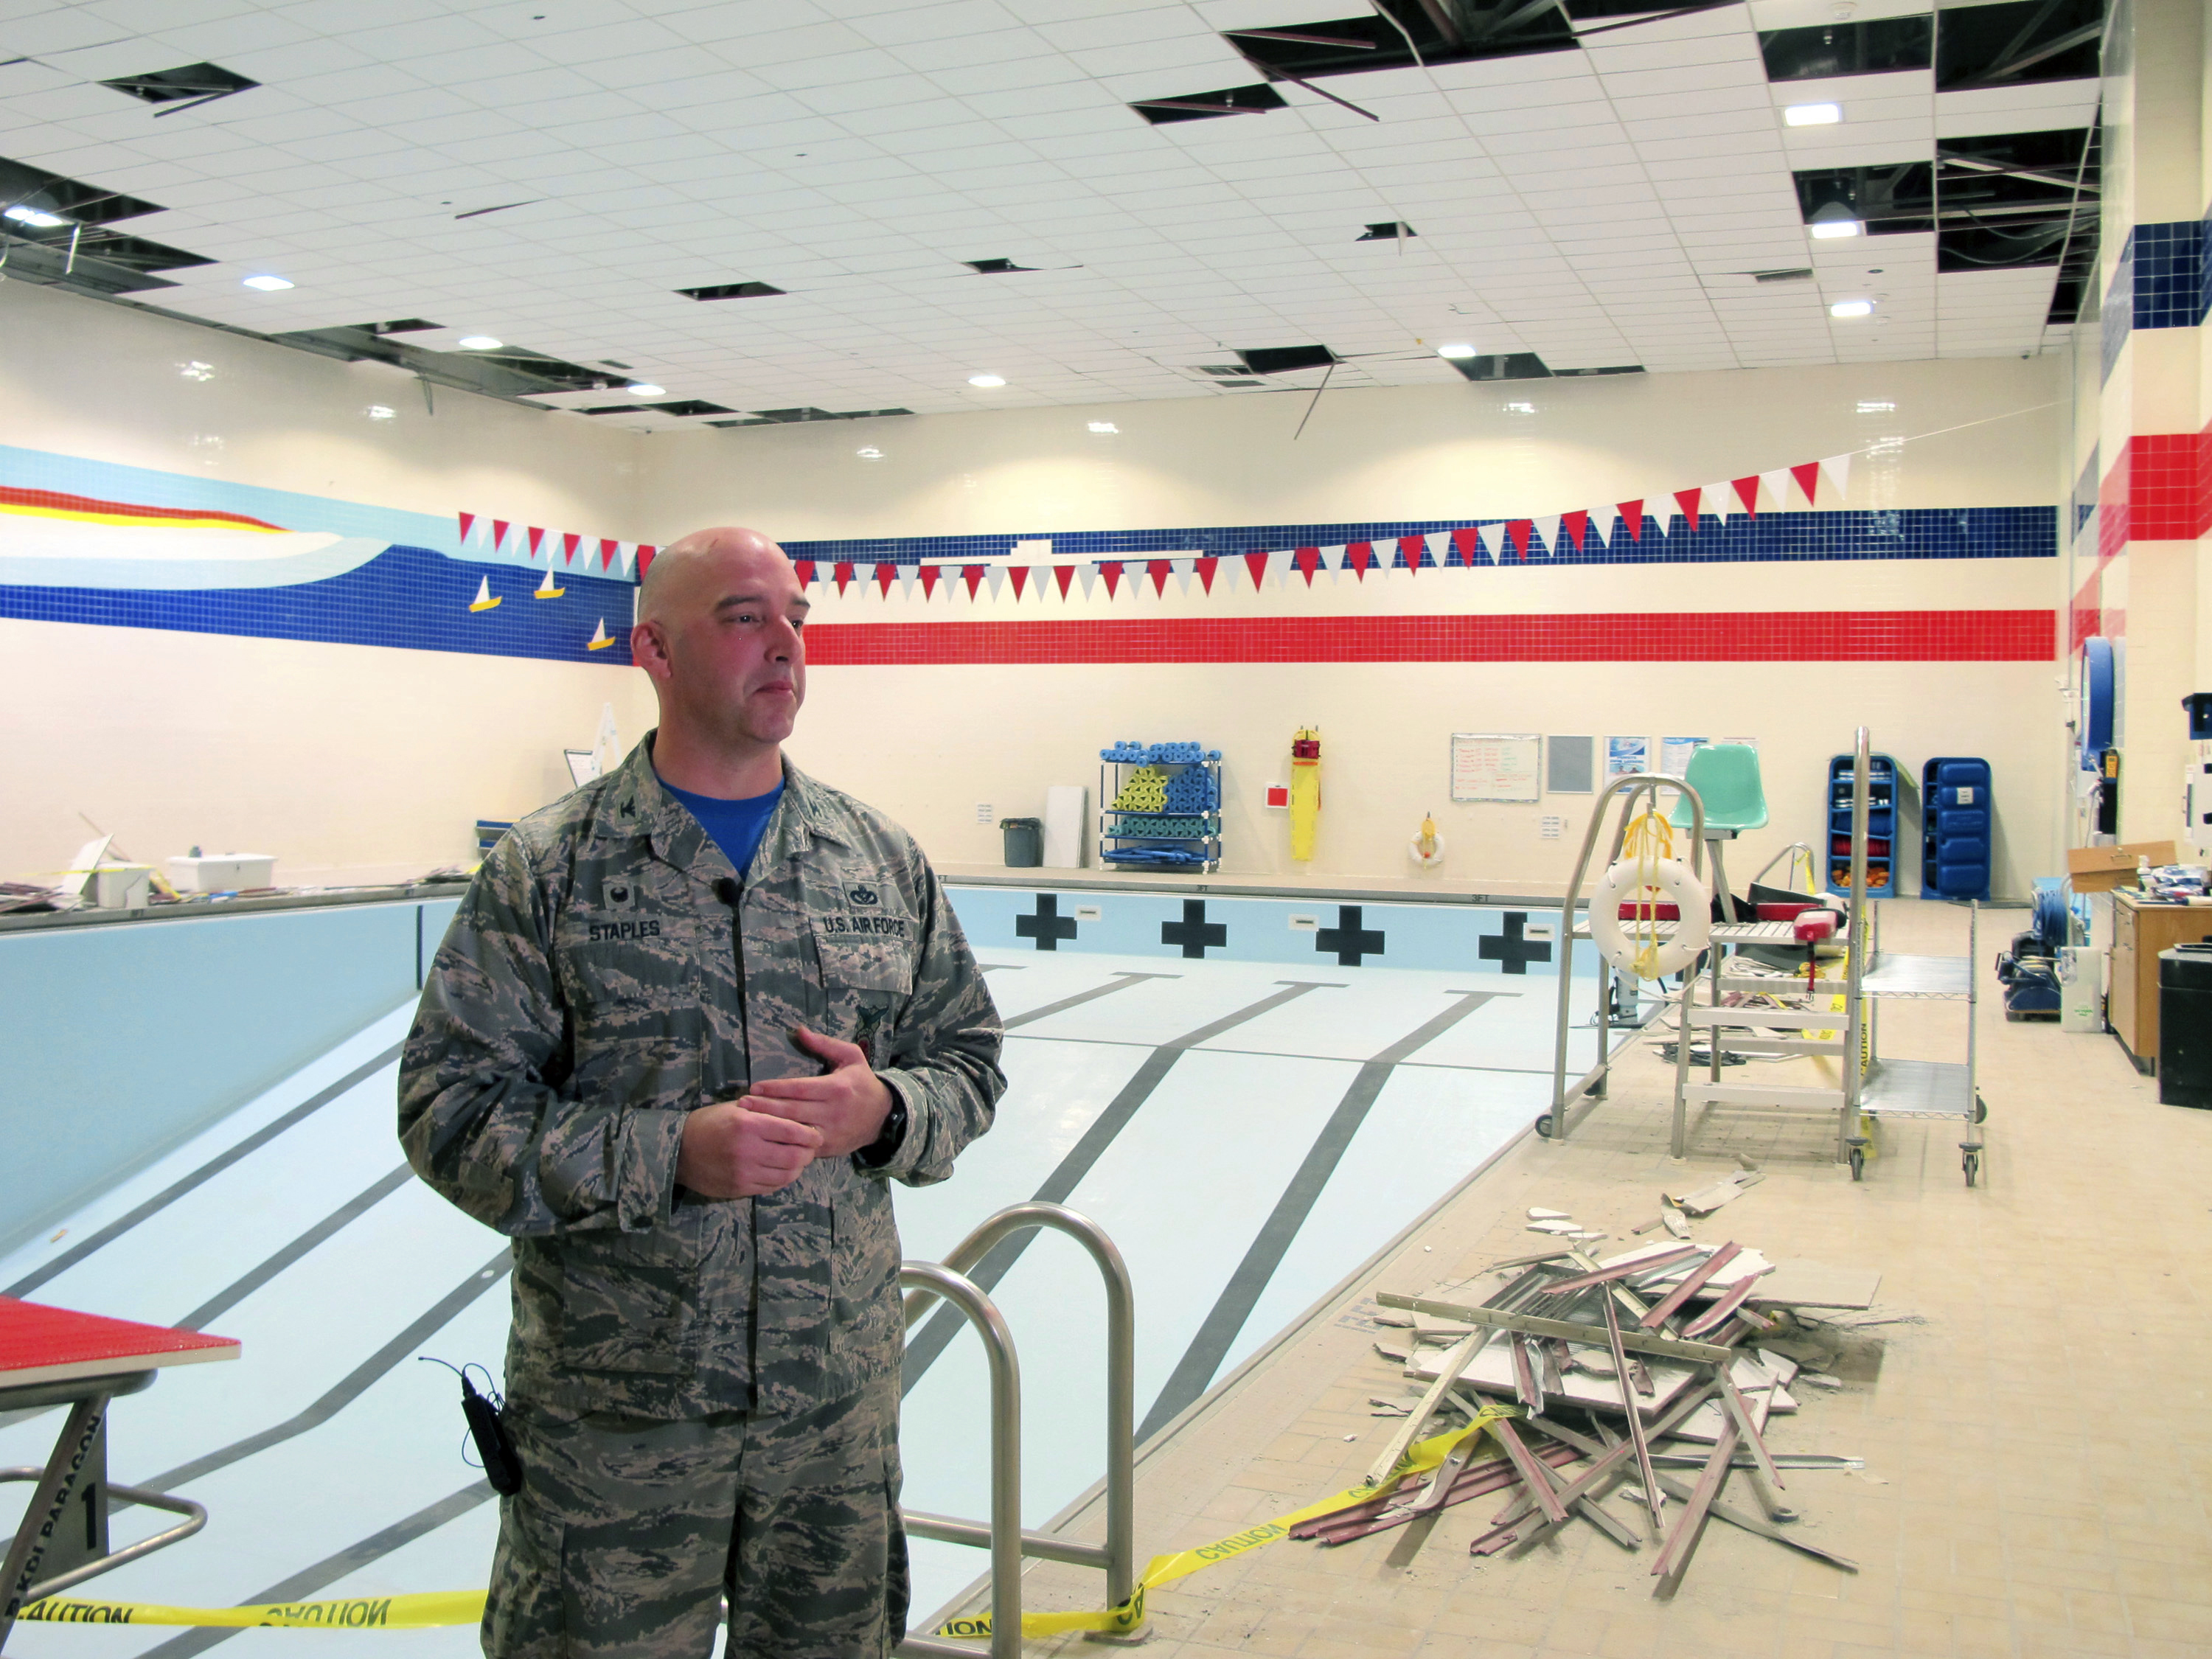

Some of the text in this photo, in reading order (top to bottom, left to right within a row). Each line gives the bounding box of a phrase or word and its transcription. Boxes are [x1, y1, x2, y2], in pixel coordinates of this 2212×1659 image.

[590, 920, 660, 941] STAPLES
[823, 917, 905, 937] U.S. AIR FORCE
[17, 1415, 102, 1593] KDI PARAGON
[81, 1482, 97, 1549] 1
[18, 1599, 133, 1624] AUTION
